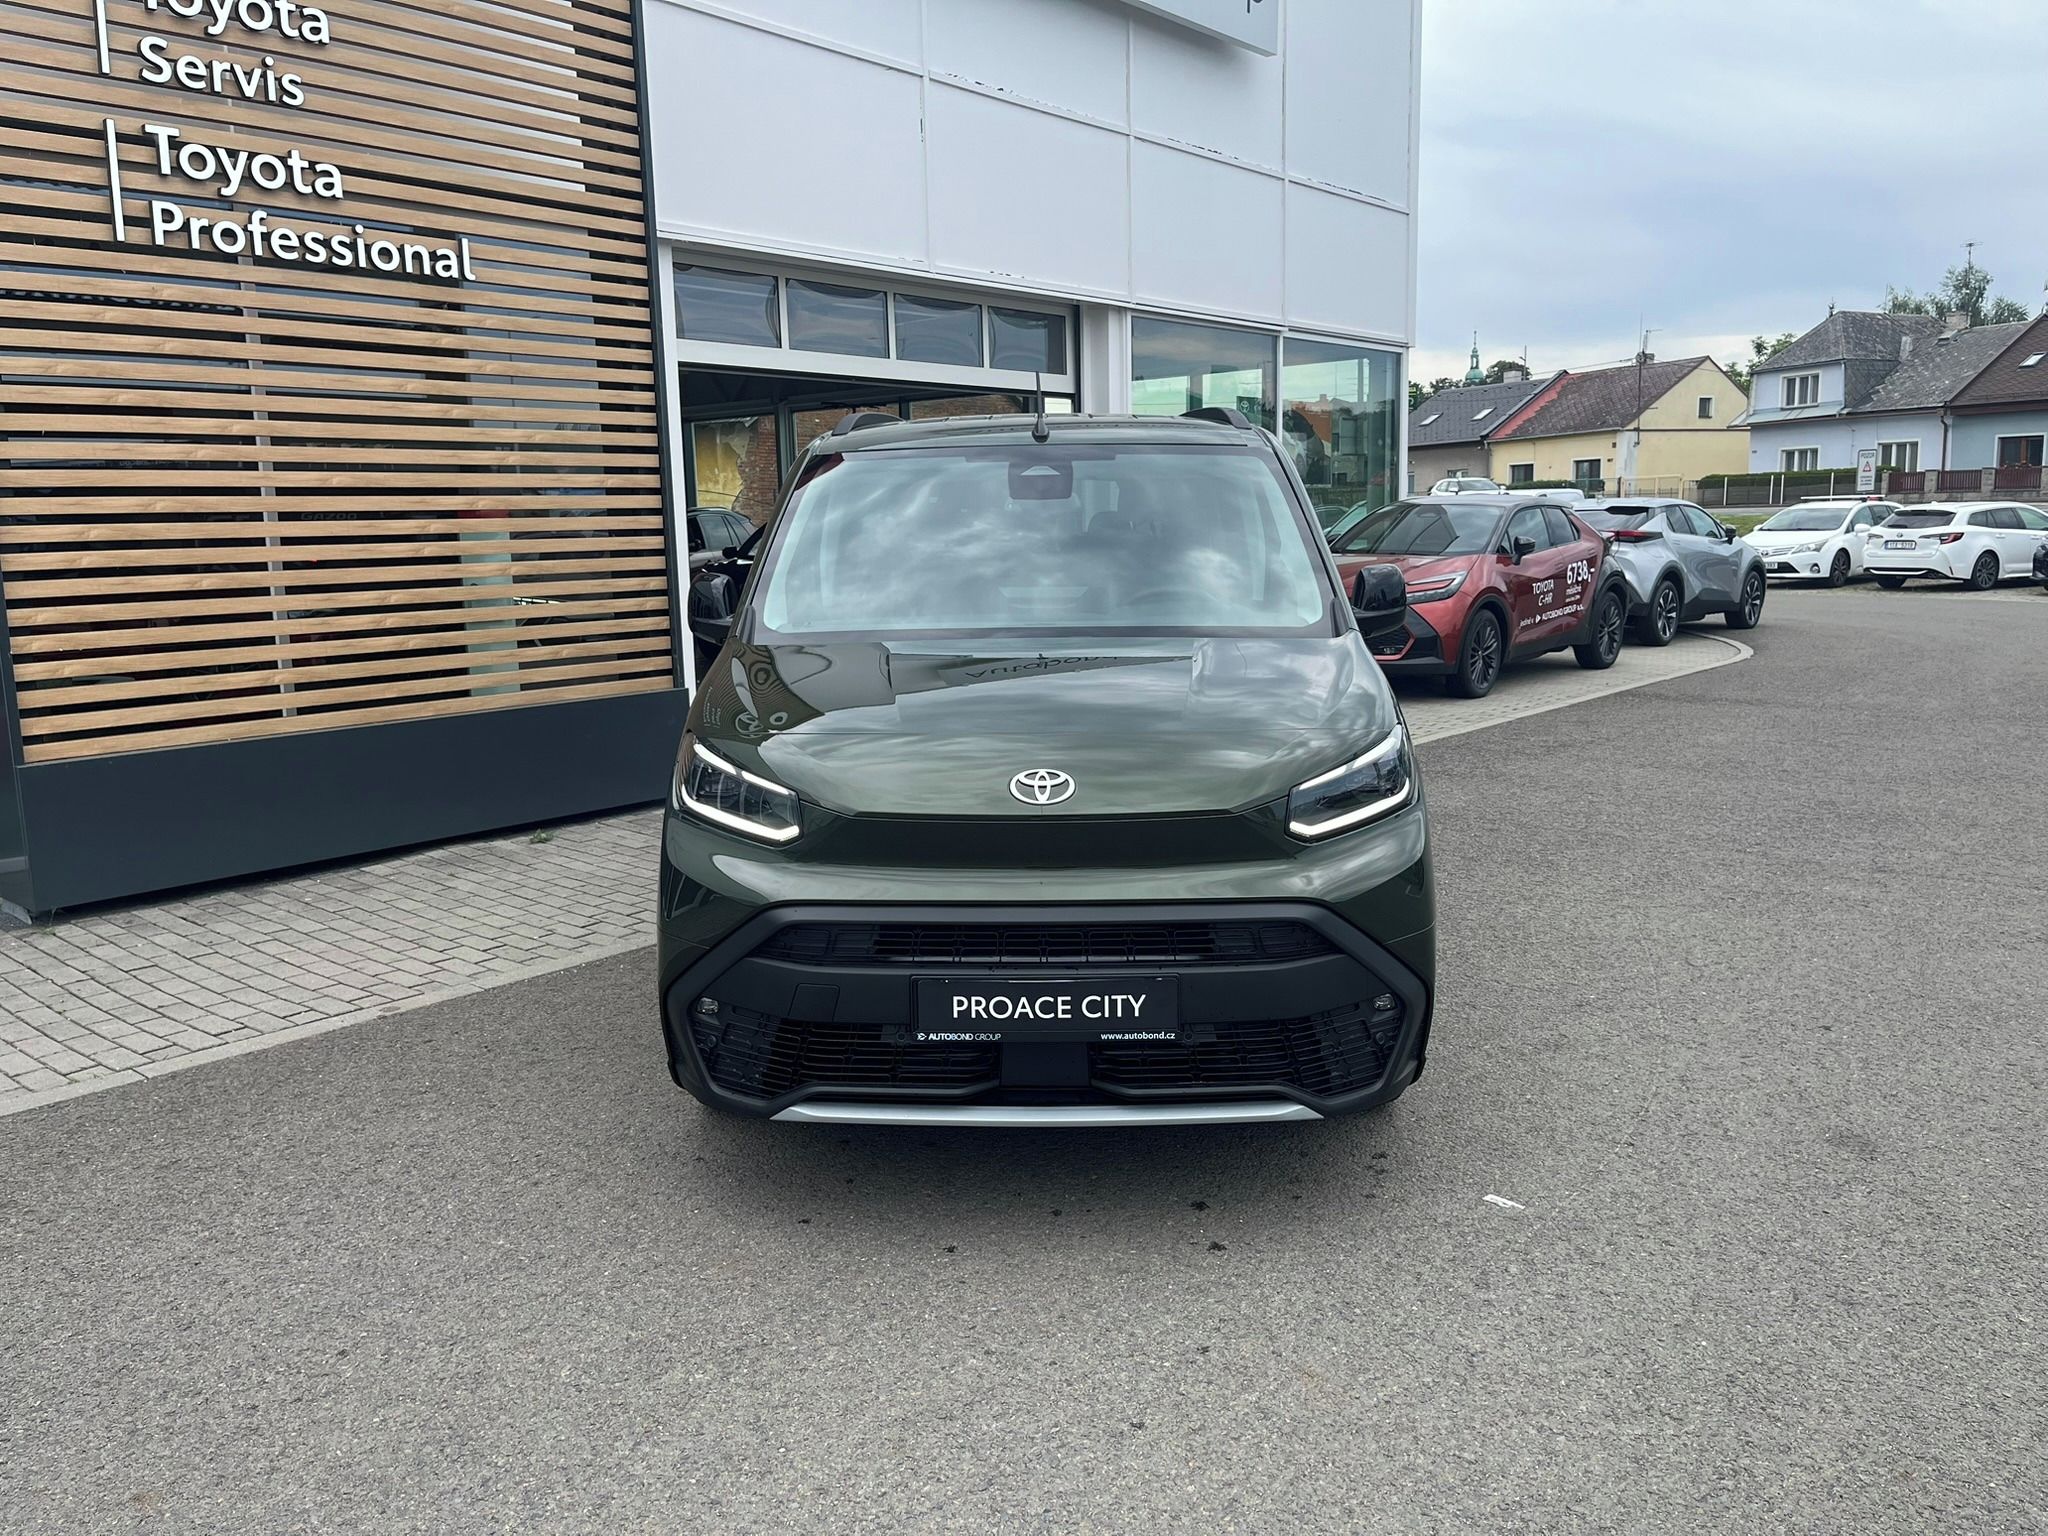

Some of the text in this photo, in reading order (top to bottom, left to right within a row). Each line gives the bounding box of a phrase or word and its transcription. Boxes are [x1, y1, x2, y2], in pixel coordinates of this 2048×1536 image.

[145, 0, 330, 44] yota
[138, 36, 305, 106] Servis
[144, 124, 343, 199] Toyota
[151, 200, 476, 280] Professional
[1532, 579, 1554, 595] TOYOTA
[1538, 592, 1553, 606] C-HR
[1542, 607, 1563, 620] AUTOBOND
[1563, 604, 1576, 615] GROUP
[952, 994, 1147, 1019] PROACE CITY
[928, 1032, 974, 1040] AUTOBOND
[1100, 1031, 1176, 1040] www.autobond.cz
